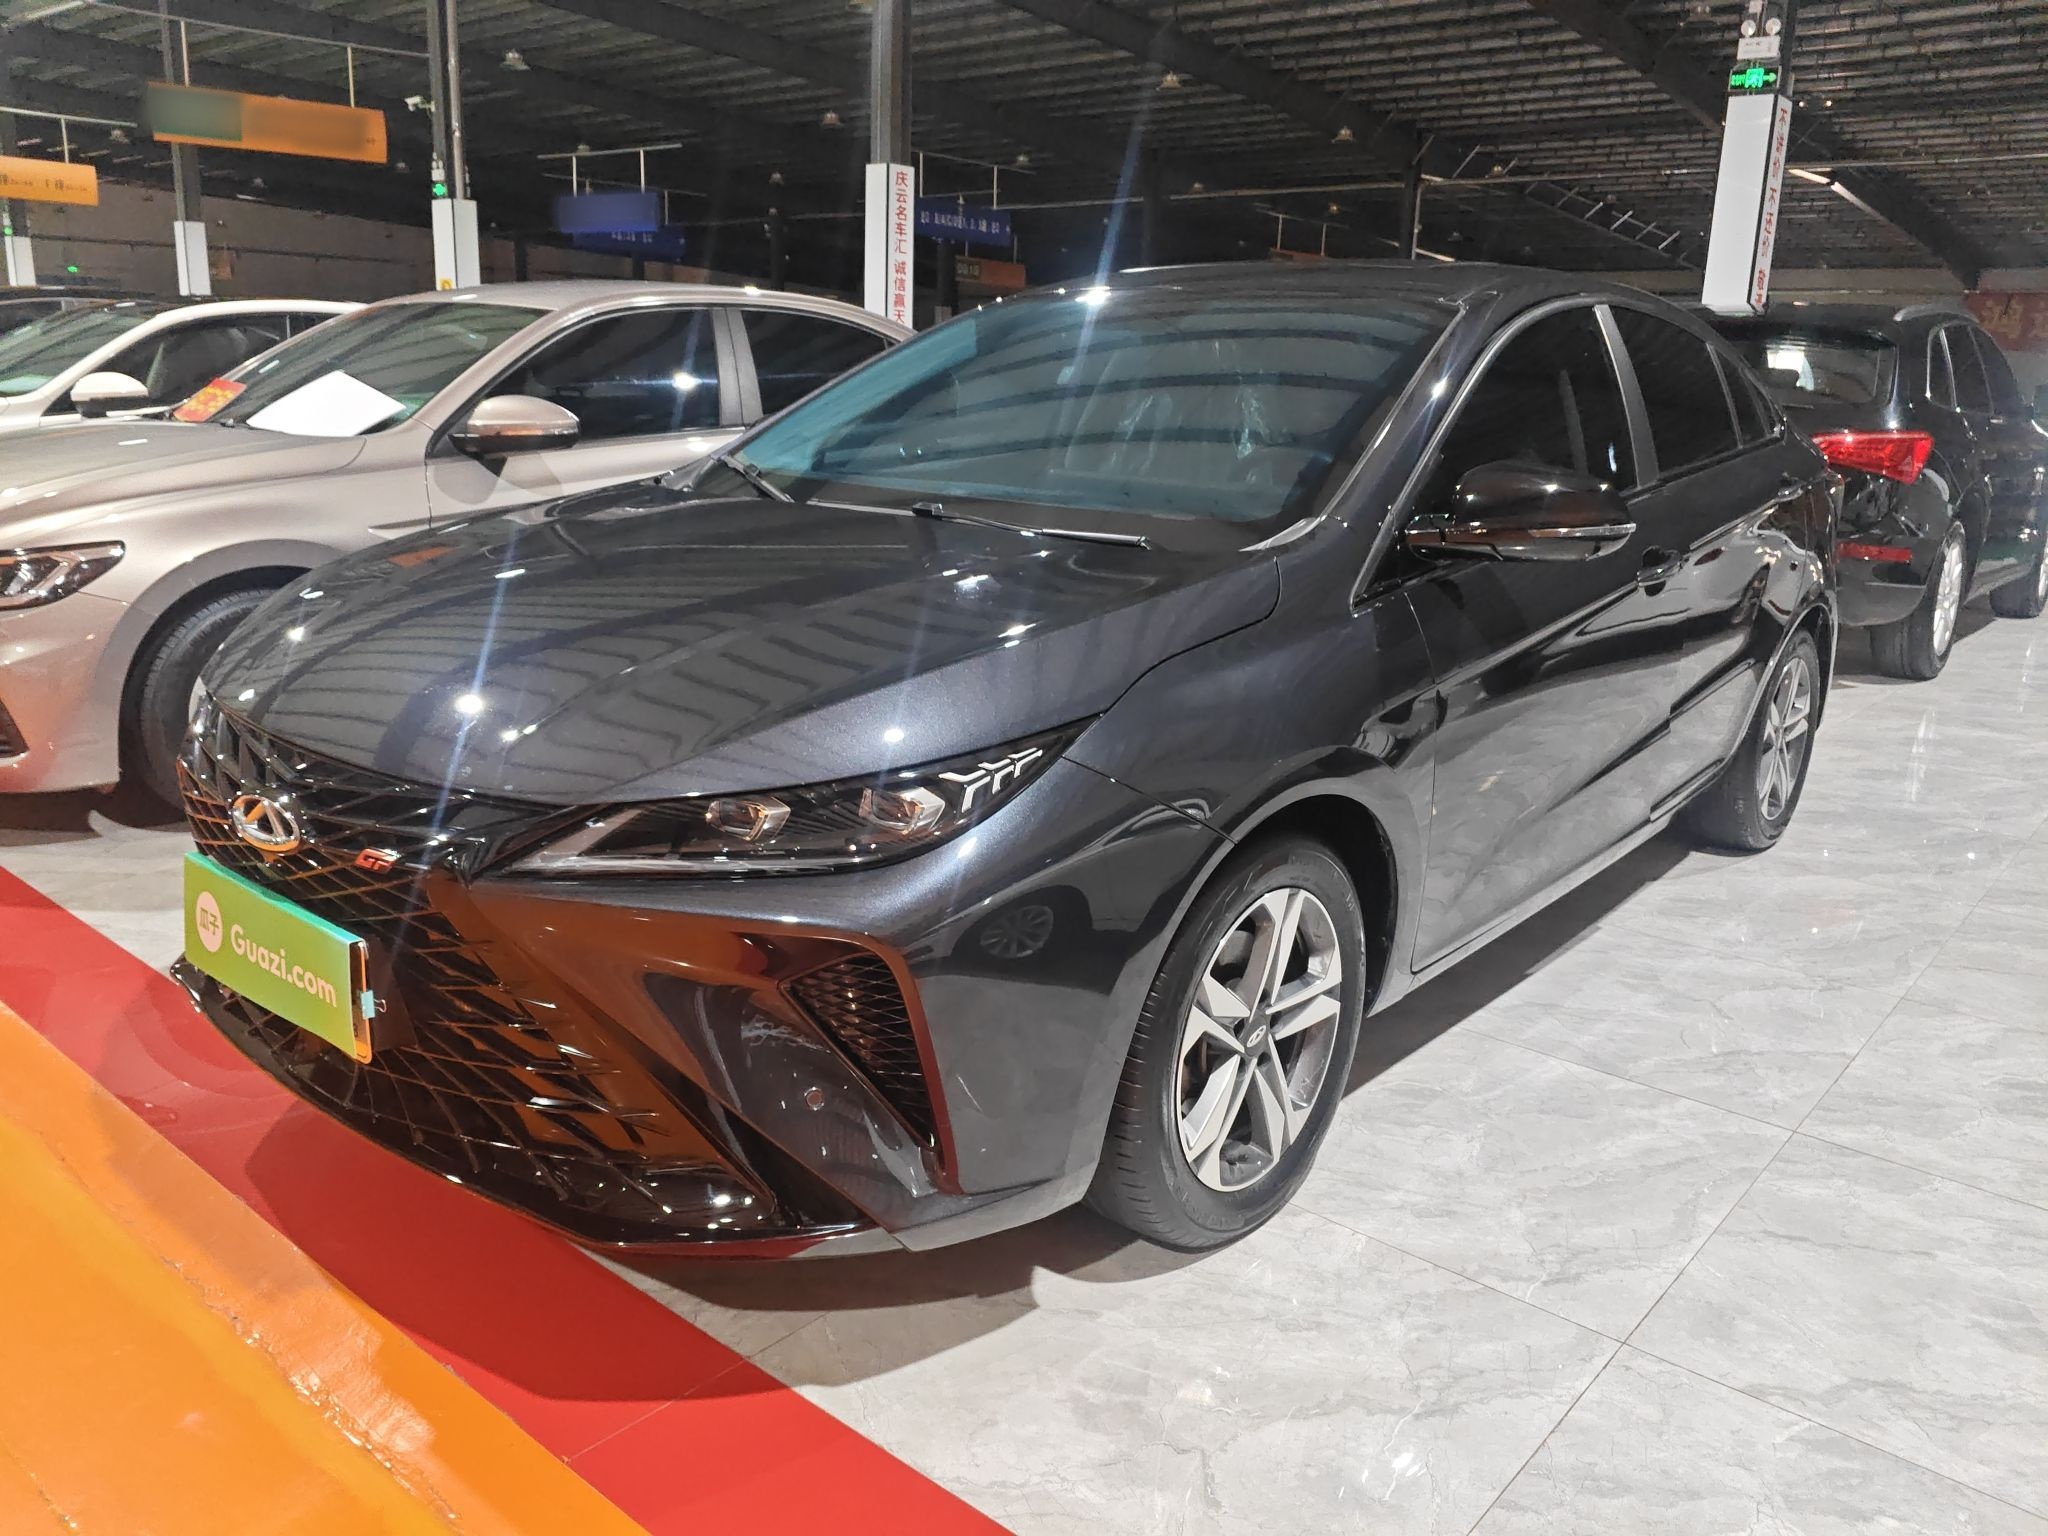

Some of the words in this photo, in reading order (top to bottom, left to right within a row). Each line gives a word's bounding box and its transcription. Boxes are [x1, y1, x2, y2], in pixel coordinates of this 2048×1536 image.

[895, 170, 909, 255] 庆云名车汇
[893, 259, 907, 324] 诚信赢天
[230, 923, 338, 1008] Guazi.com
